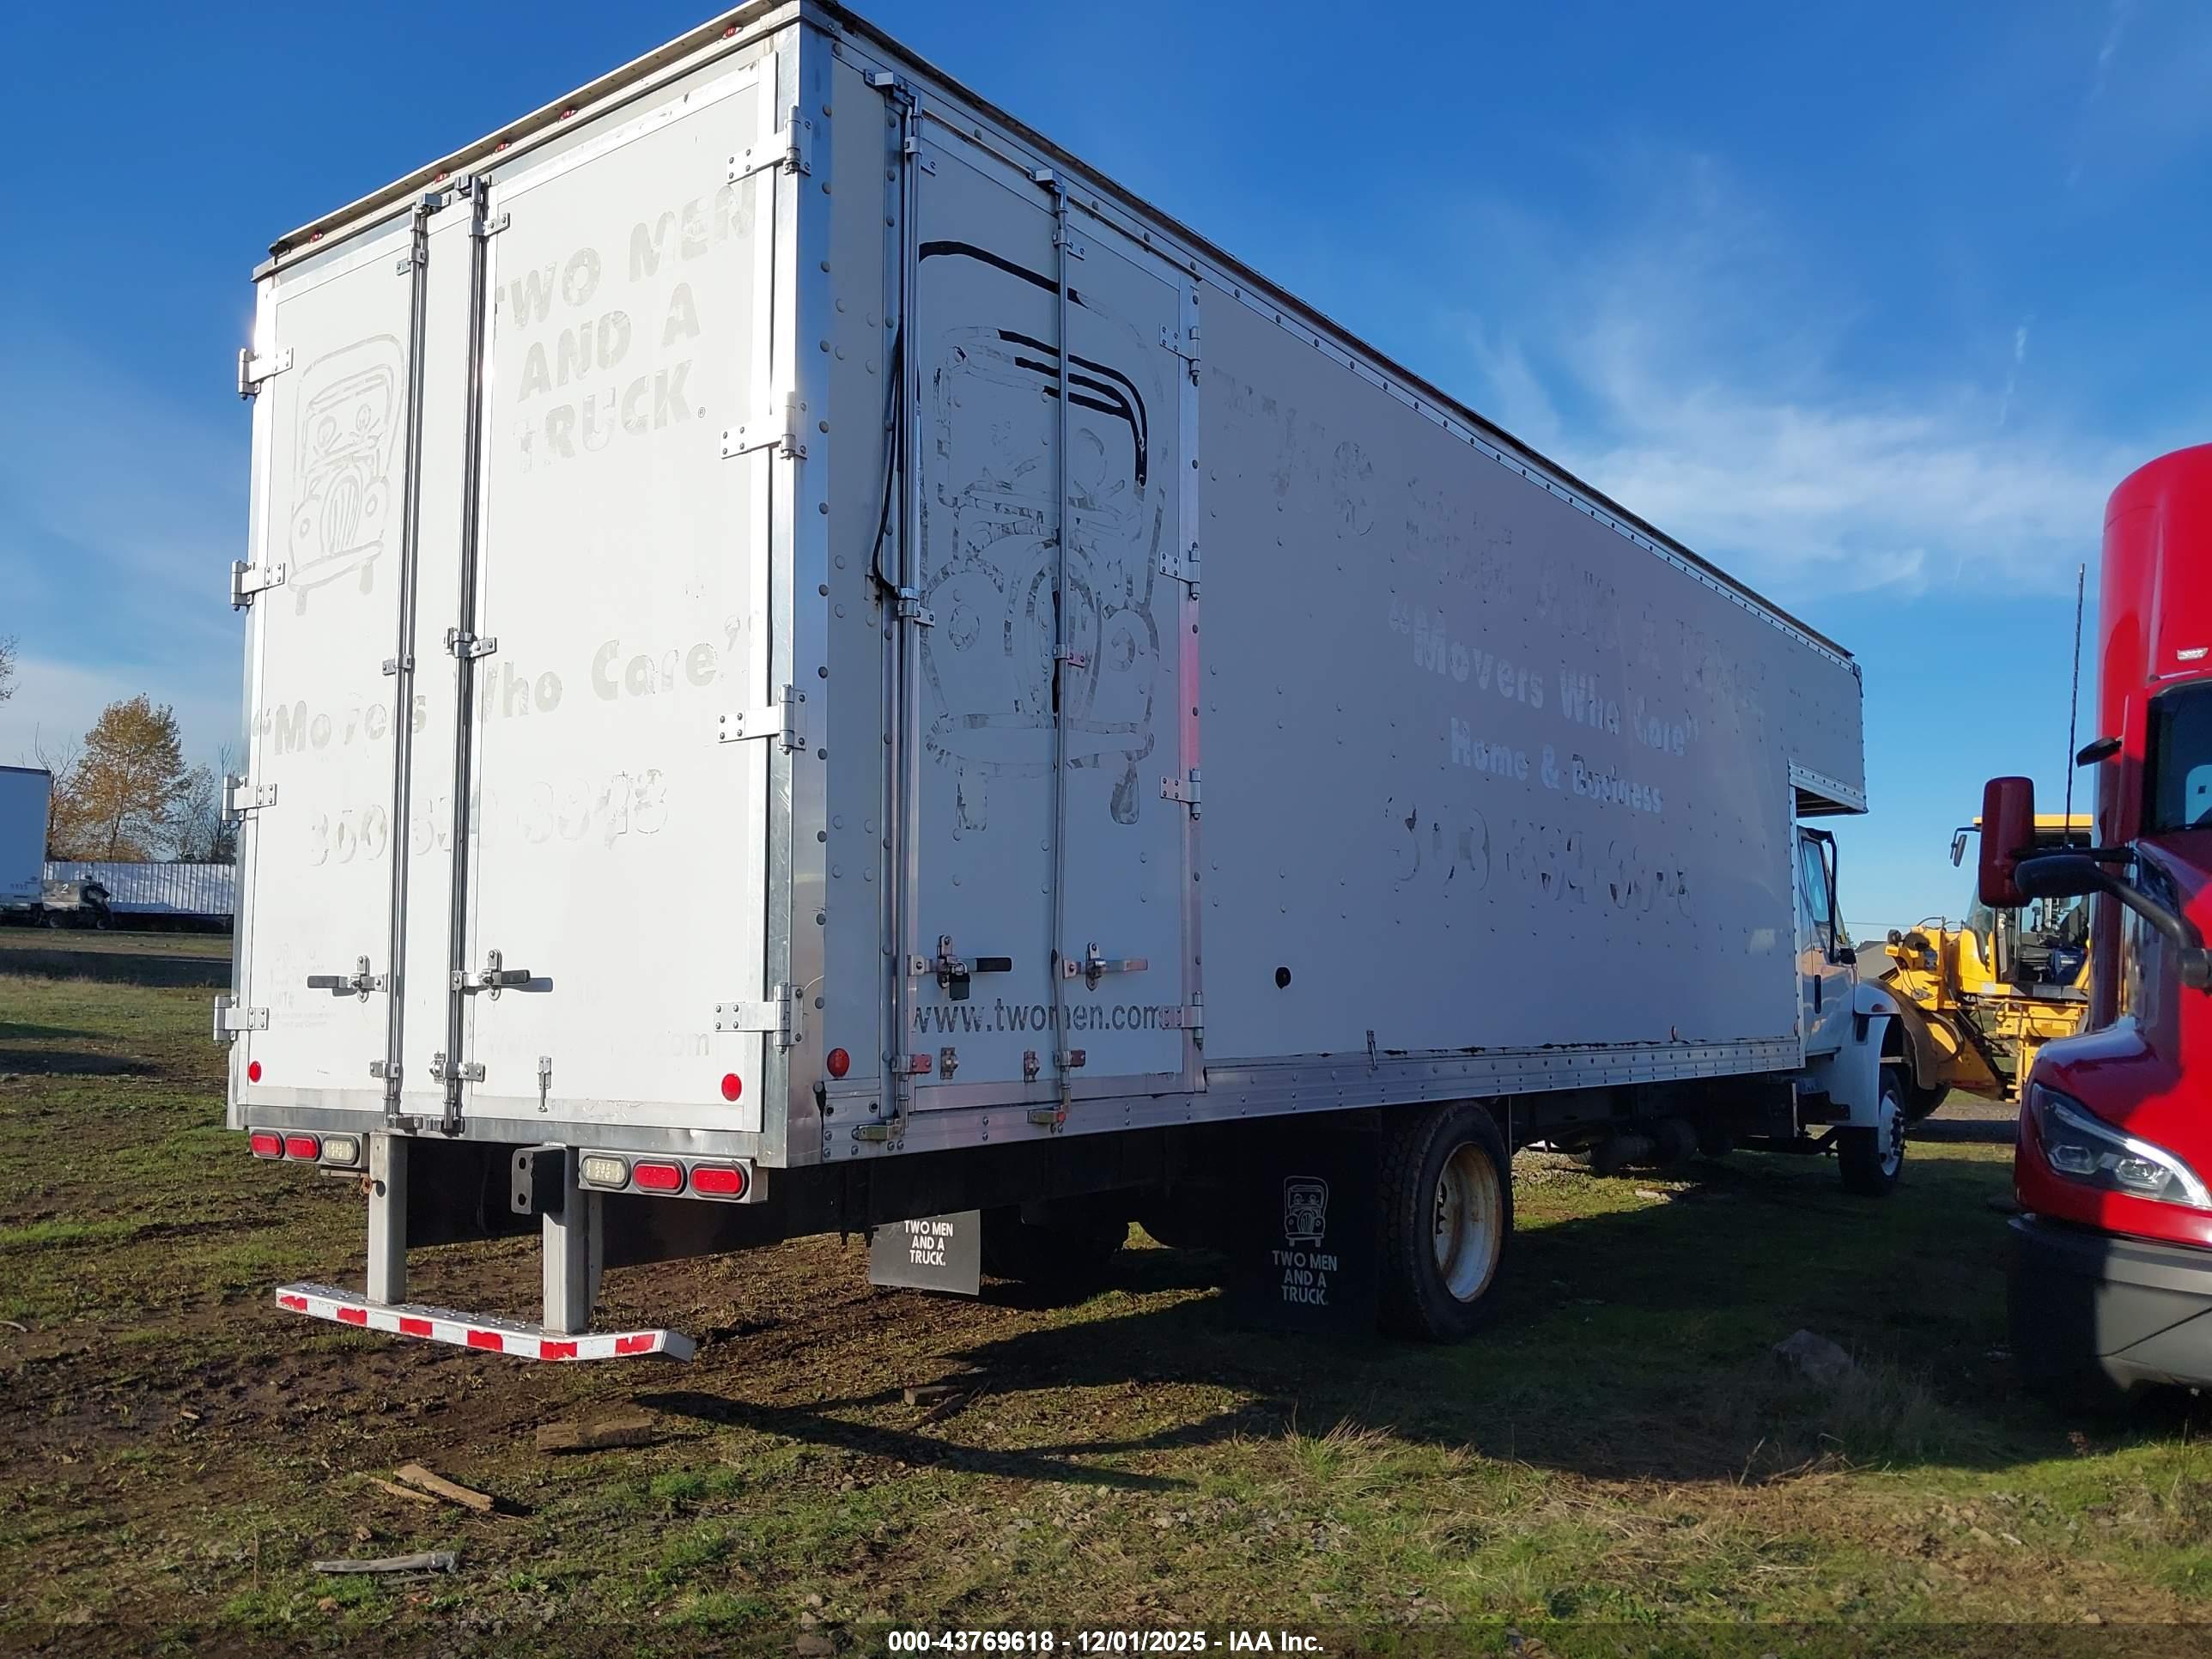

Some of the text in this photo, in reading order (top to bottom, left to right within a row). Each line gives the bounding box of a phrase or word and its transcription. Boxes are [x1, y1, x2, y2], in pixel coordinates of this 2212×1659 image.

[496, 177, 757, 331] WO MEN
[517, 282, 702, 403] AND A
[1449, 714, 1664, 814] Home & Business
[904, 1219, 953, 1237] TWO MEN
[911, 1235, 945, 1251] AND A
[1272, 1249, 1337, 1271] TWO MEN
[1284, 1268, 1327, 1287] AND A
